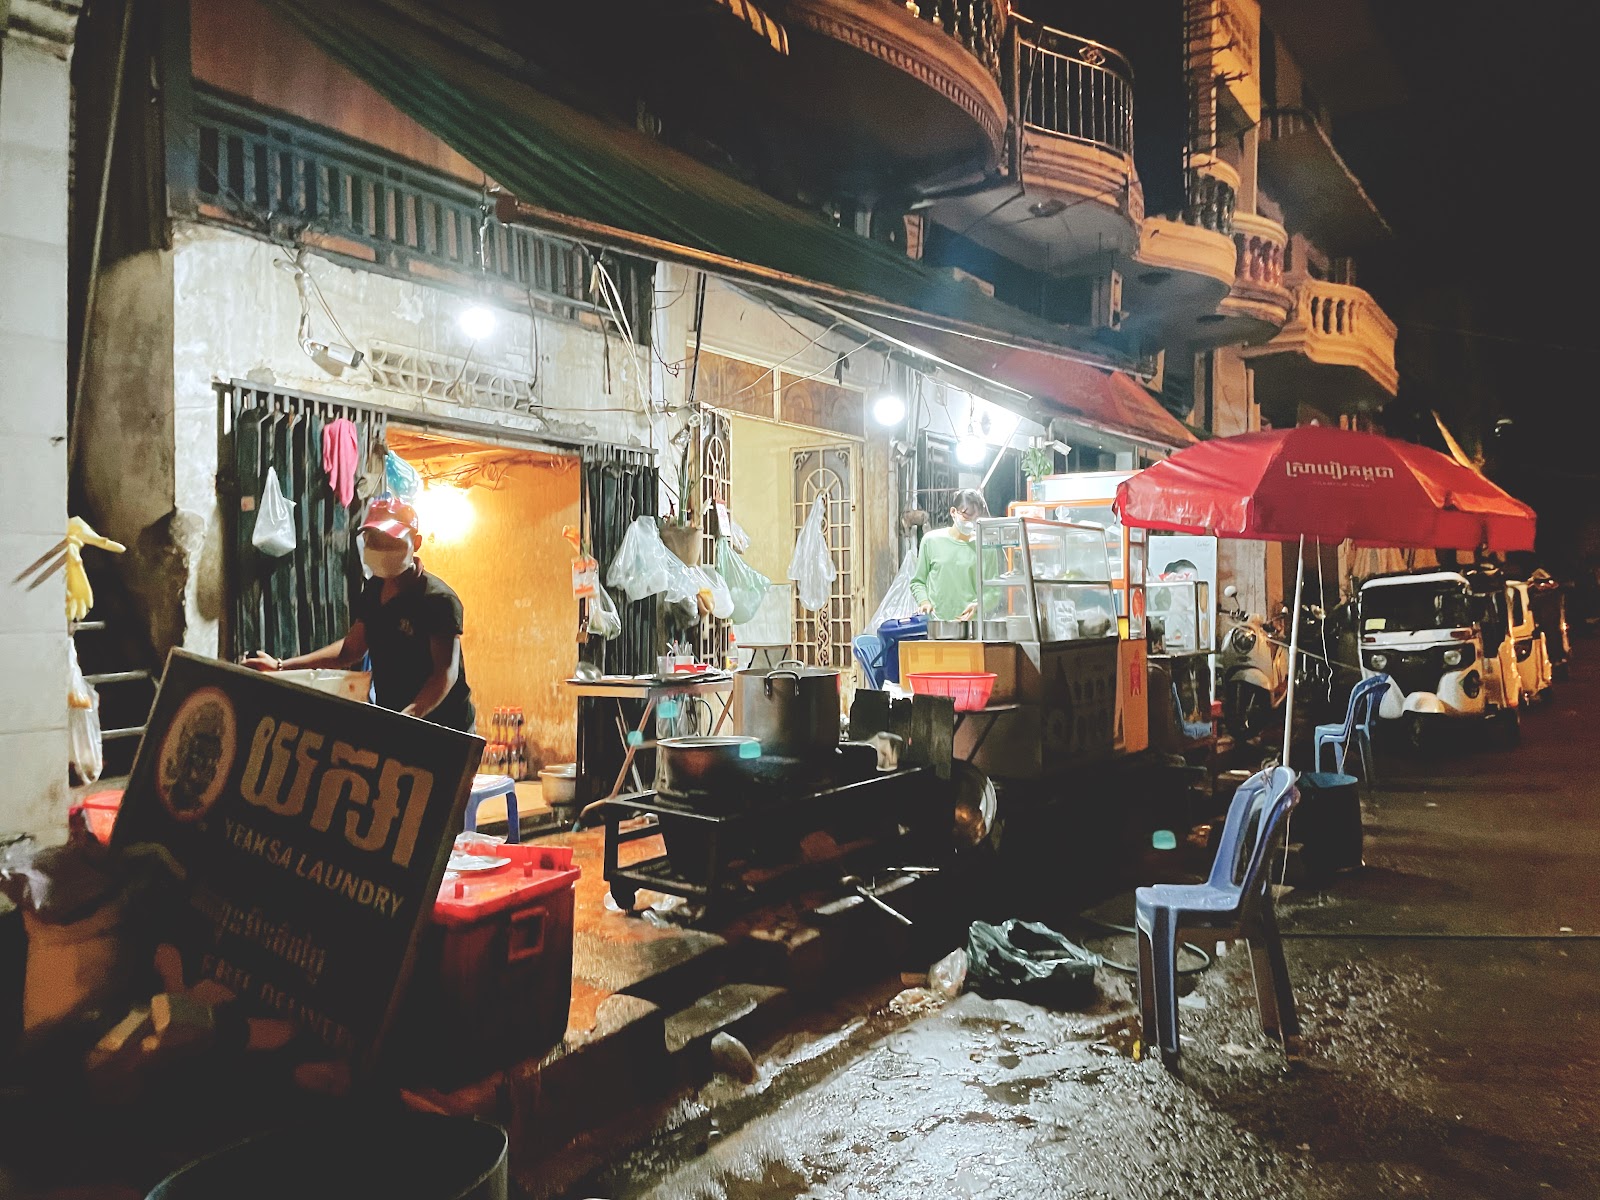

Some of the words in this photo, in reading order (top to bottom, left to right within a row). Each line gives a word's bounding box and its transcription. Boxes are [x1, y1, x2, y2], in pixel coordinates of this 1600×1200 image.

[240, 715, 434, 869] យក្សា
[224, 817, 293, 870] YEAKSA
[295, 852, 406, 919] LAUNDRY
